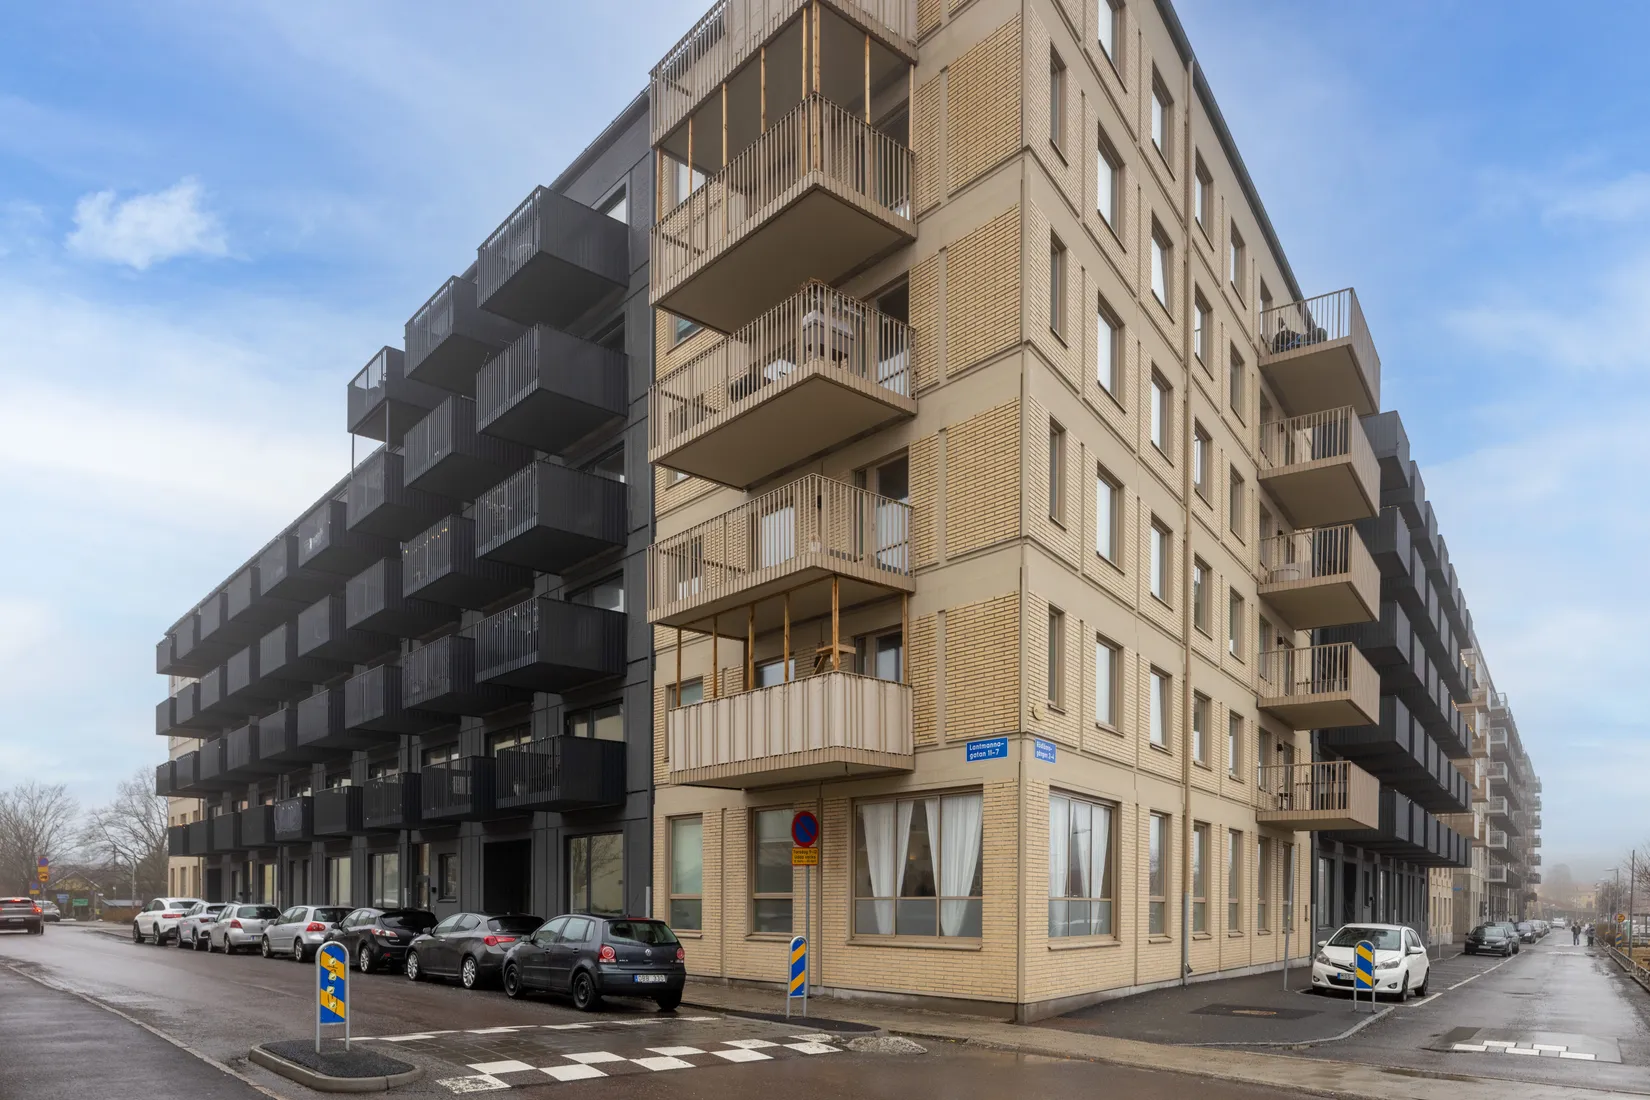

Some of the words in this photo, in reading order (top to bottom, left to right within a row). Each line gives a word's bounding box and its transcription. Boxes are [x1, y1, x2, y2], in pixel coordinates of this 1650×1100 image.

[969, 741, 1005, 751] Lantmanna-
[969, 751, 987, 760] gatan
[987, 748, 1000, 756] 11-7
